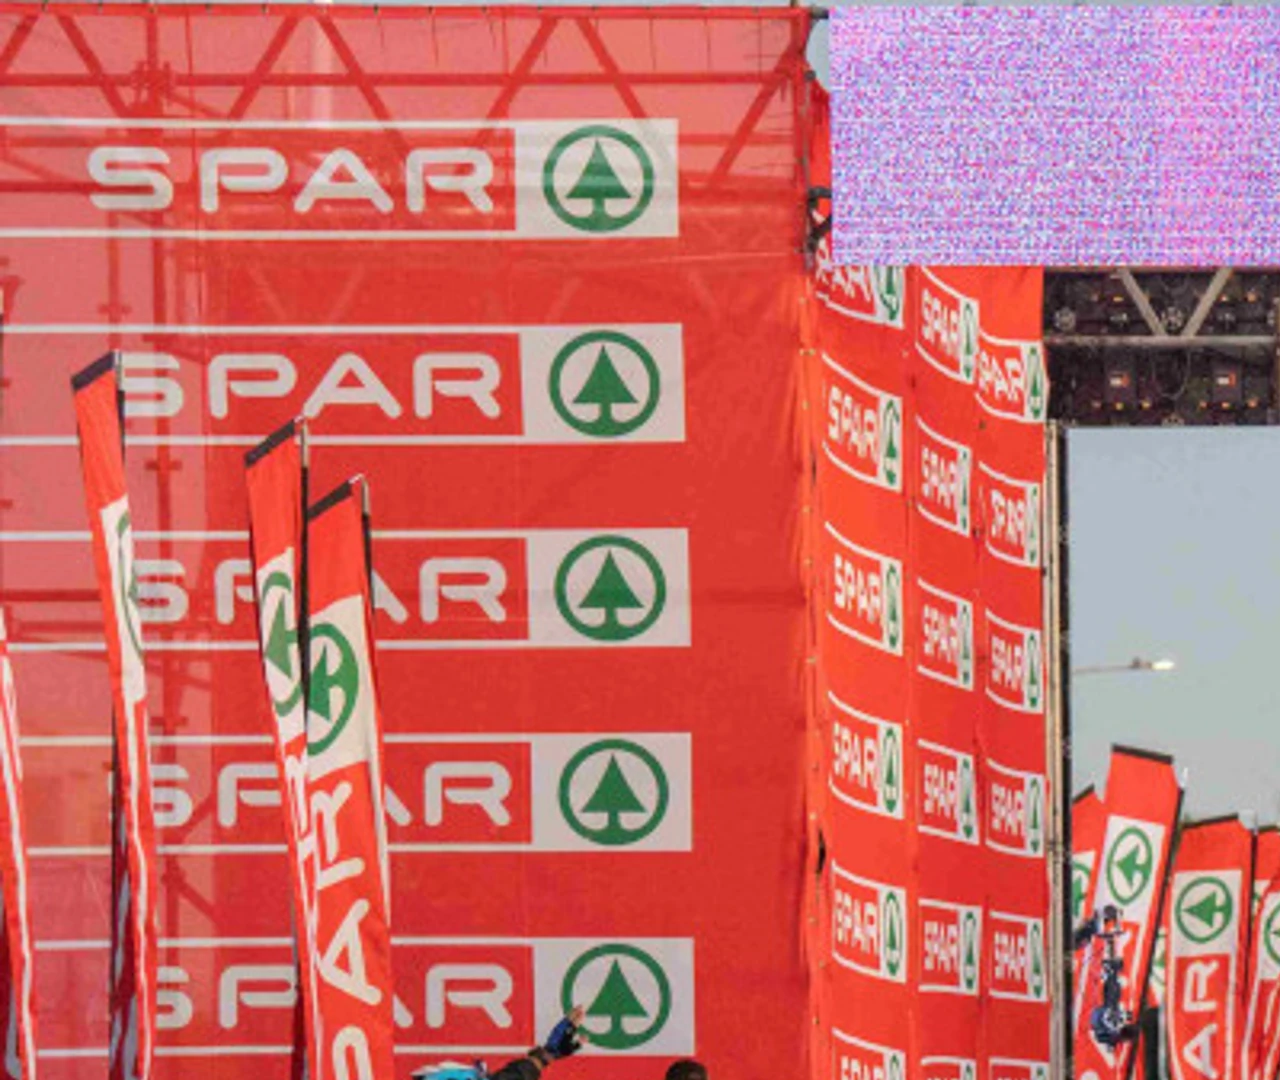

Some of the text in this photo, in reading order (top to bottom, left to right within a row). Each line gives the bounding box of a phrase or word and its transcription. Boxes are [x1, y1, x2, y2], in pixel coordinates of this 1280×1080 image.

[88, 147, 494, 214] SPAR
[923, 288, 961, 357] SPAR
[122, 353, 501, 420] SPAR
[829, 385, 880, 460] SPAR
[921, 447, 959, 512] SPAR
[834, 554, 882, 624] SPAR
[923, 605, 960, 668] SPAR
[992, 636, 1025, 694] SPAR
[833, 722, 879, 792] SPAR
[924, 765, 958, 821] SPAR
[991, 783, 1026, 839] SPAR
[834, 888, 881, 957] SPAR
[925, 921, 958, 974] SPAR
[995, 932, 1028, 982] SPAR
